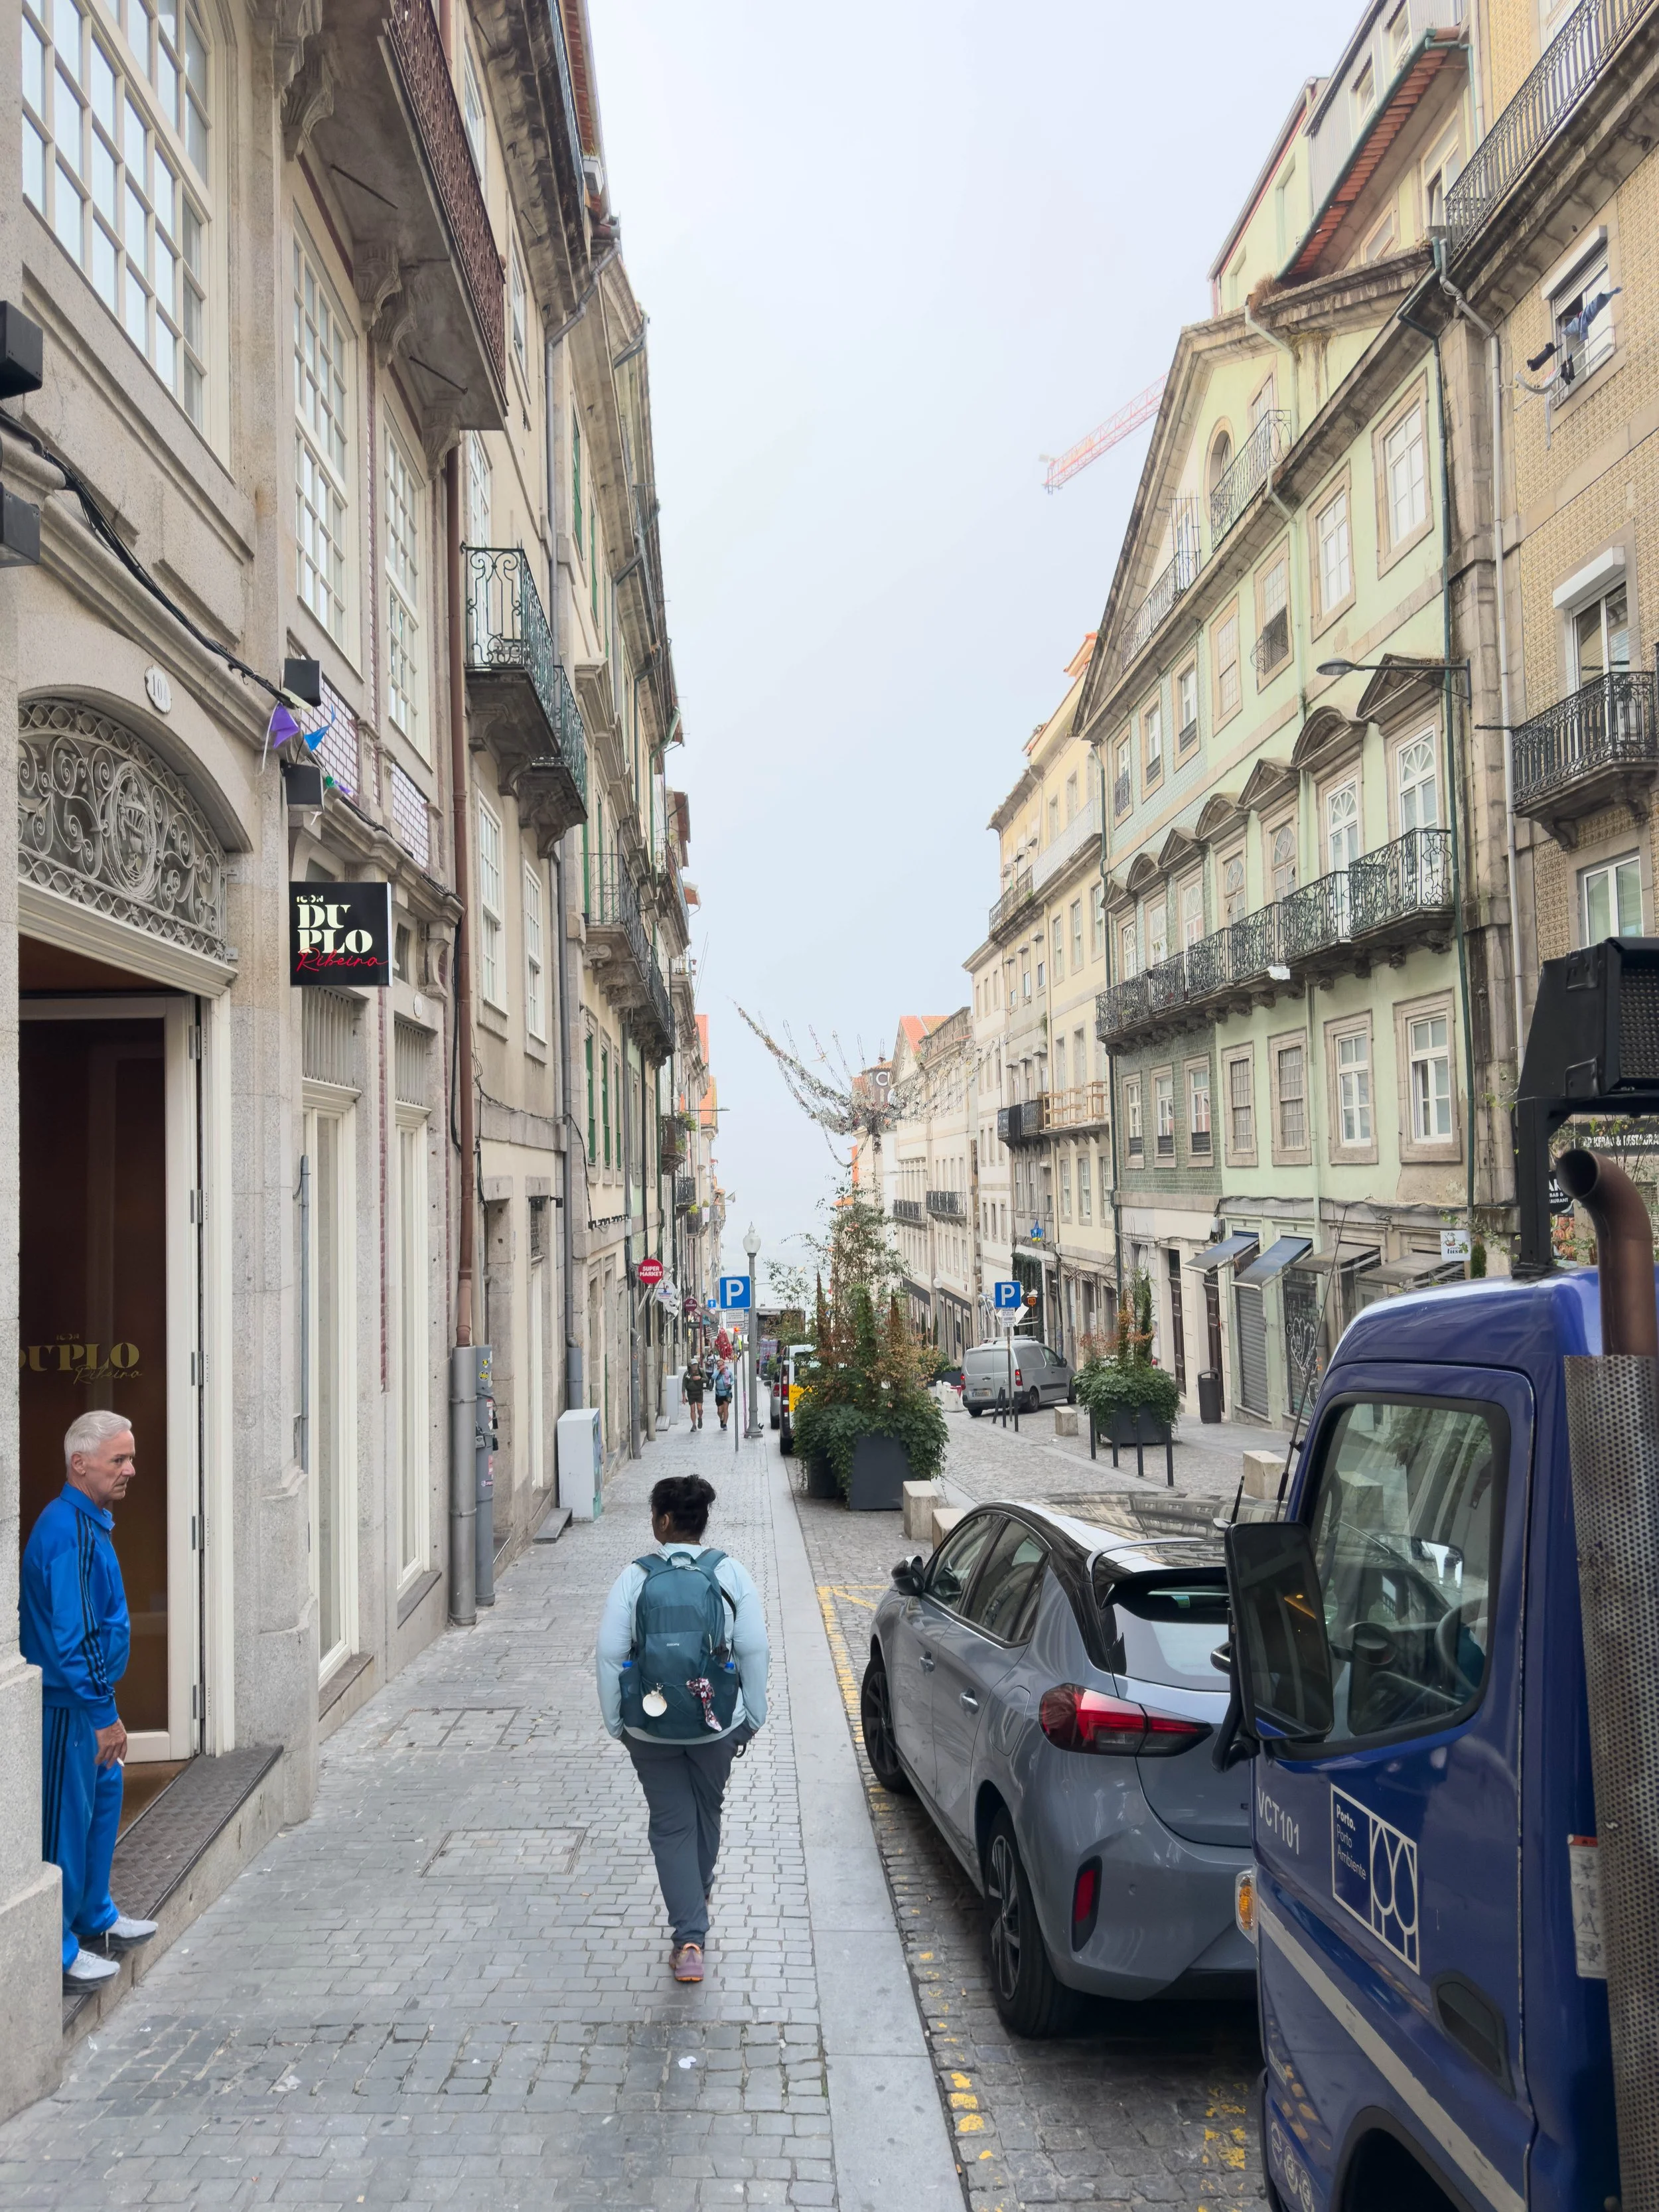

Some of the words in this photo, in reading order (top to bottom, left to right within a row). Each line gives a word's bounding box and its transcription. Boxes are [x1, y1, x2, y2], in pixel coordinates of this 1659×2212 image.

[297, 895, 324, 903] ICON
[297, 905, 352, 928] DU
[297, 929, 373, 954] PLO
[297, 947, 389, 972] Ribeira
[1616, 1135, 1622, 1146] &
[1623, 1133, 1659, 1146] RESTAURA
[726, 1280, 744, 1306] P
[1001, 1284, 1015, 1305] P
[1257, 1786, 1299, 1856] VCT101
[1336, 1804, 1356, 1832] Porto.
[1336, 1824, 1352, 1848] Porto
[1337, 1844, 1366, 1880] Ambiente
